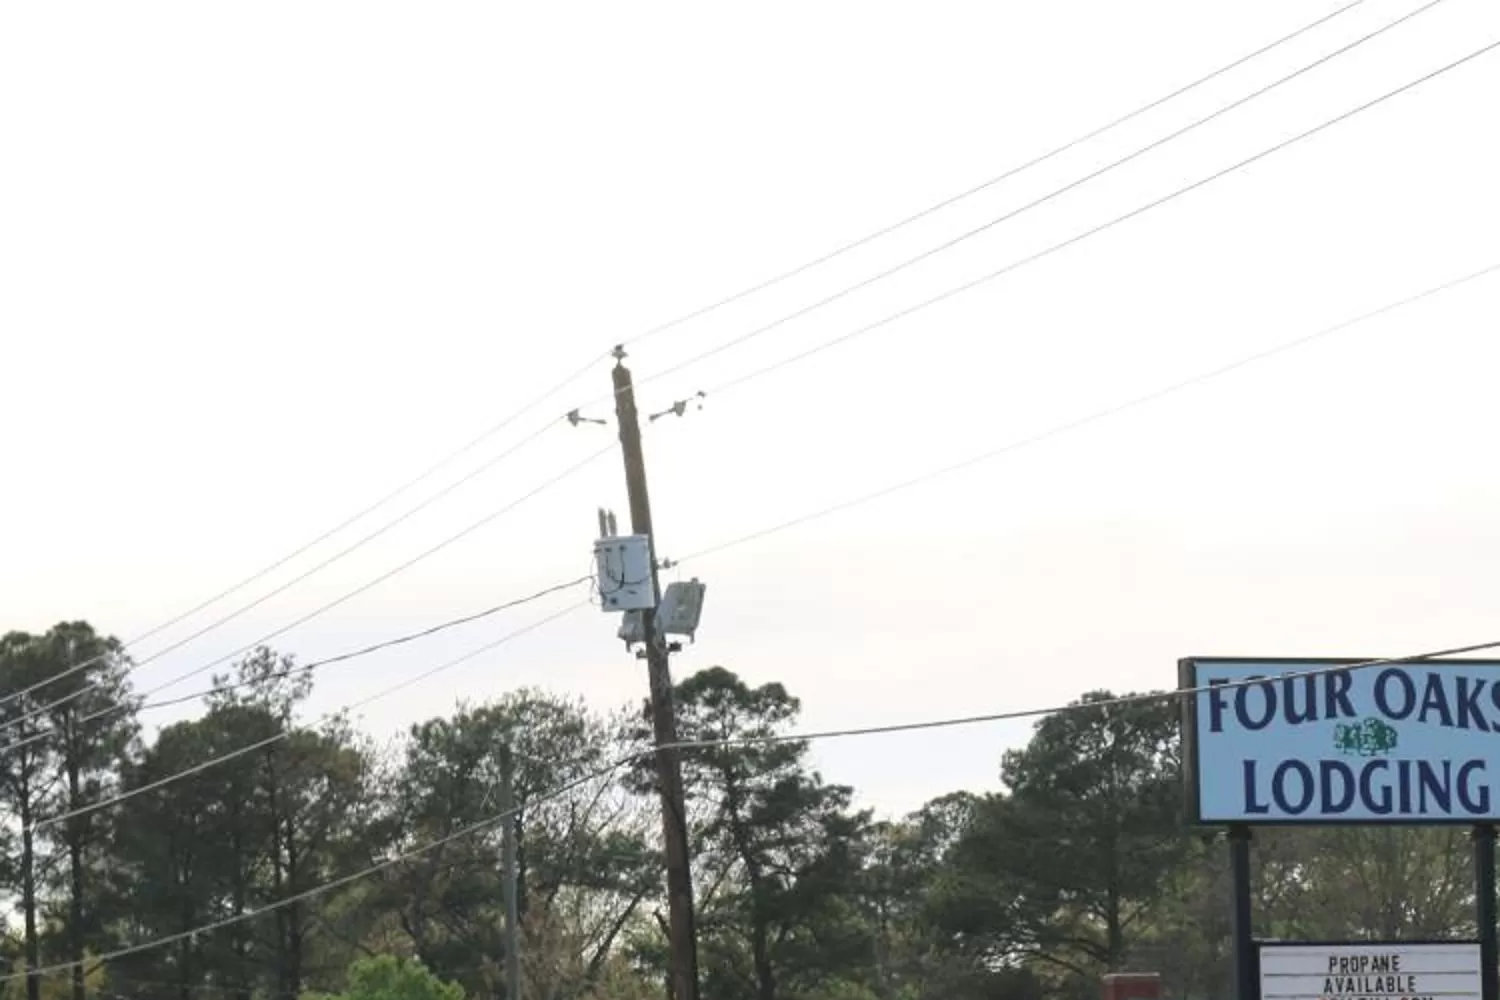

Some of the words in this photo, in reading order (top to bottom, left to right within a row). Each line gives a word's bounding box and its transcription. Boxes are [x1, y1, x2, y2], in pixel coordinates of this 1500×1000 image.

[1208, 667, 1356, 733] FOUR
[1243, 758, 1490, 814] LODGING
[1328, 954, 1401, 973] PROPANE
[1323, 975, 1416, 993] AVAILABLE
